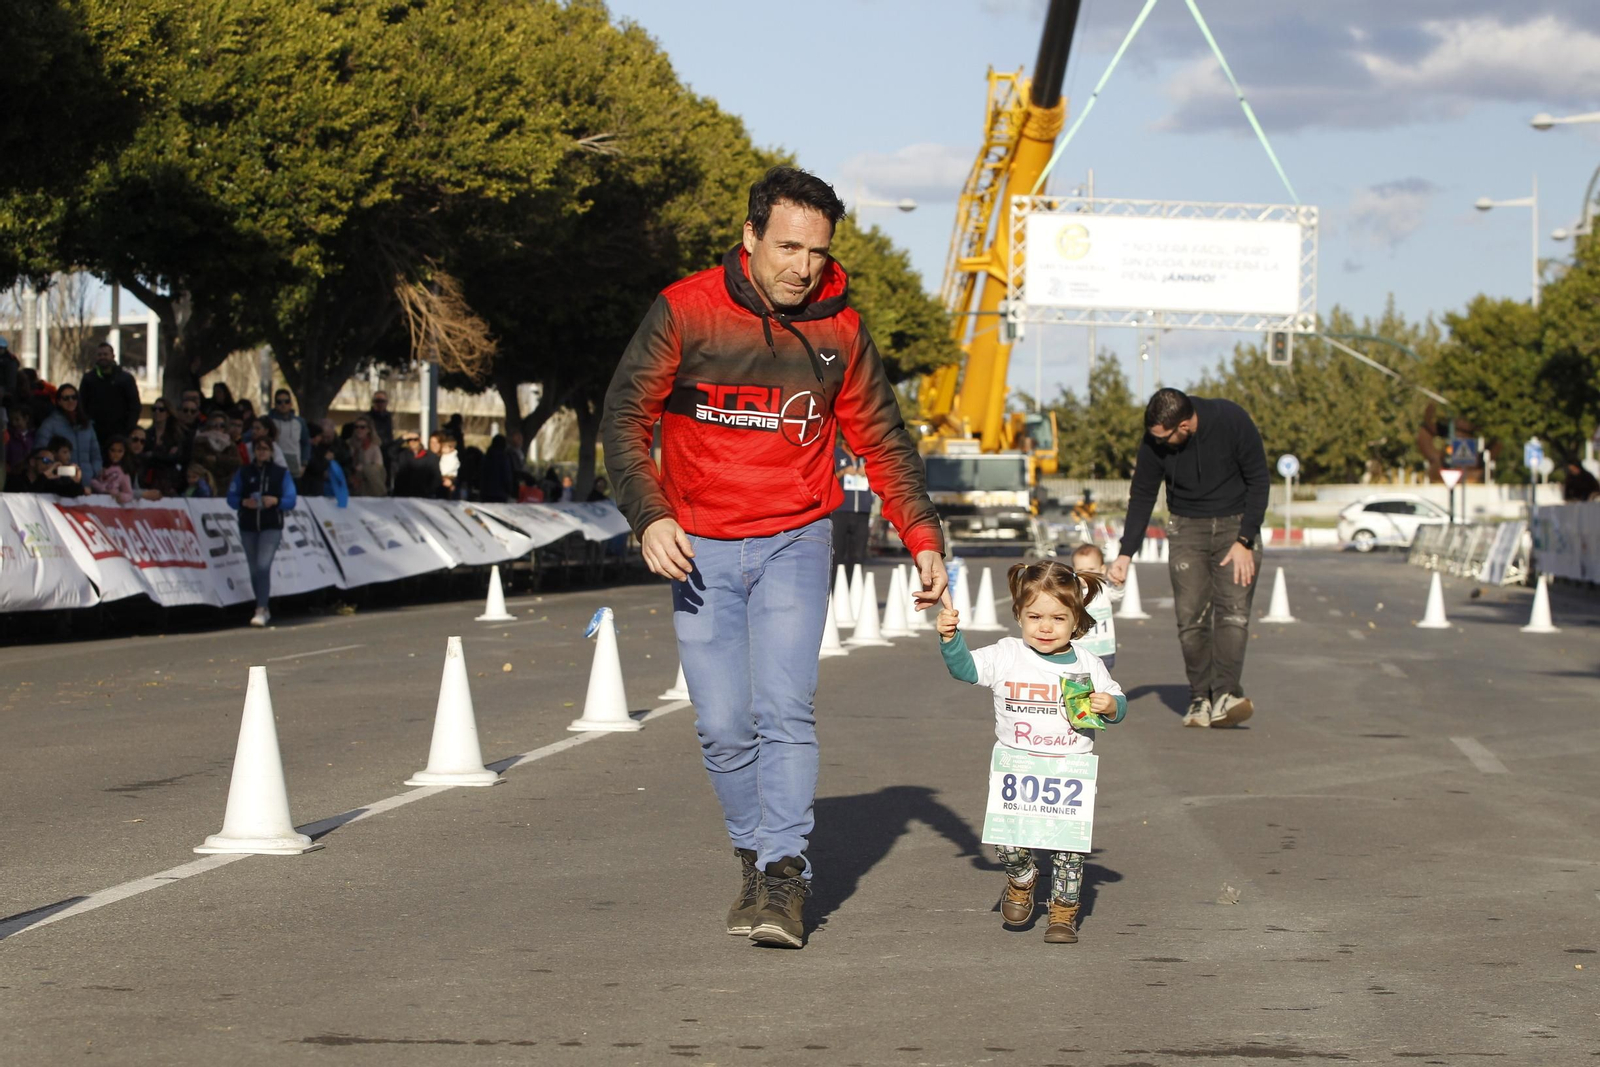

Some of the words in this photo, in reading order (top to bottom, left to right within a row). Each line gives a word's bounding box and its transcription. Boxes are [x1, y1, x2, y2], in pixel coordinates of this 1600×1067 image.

[696, 382, 781, 413] TRI
[1004, 681, 1058, 702] TRI
[1001, 773, 1083, 807] 8052
[1003, 802, 1038, 813] ROSALIA
[1040, 805, 1077, 815] RUNNER
